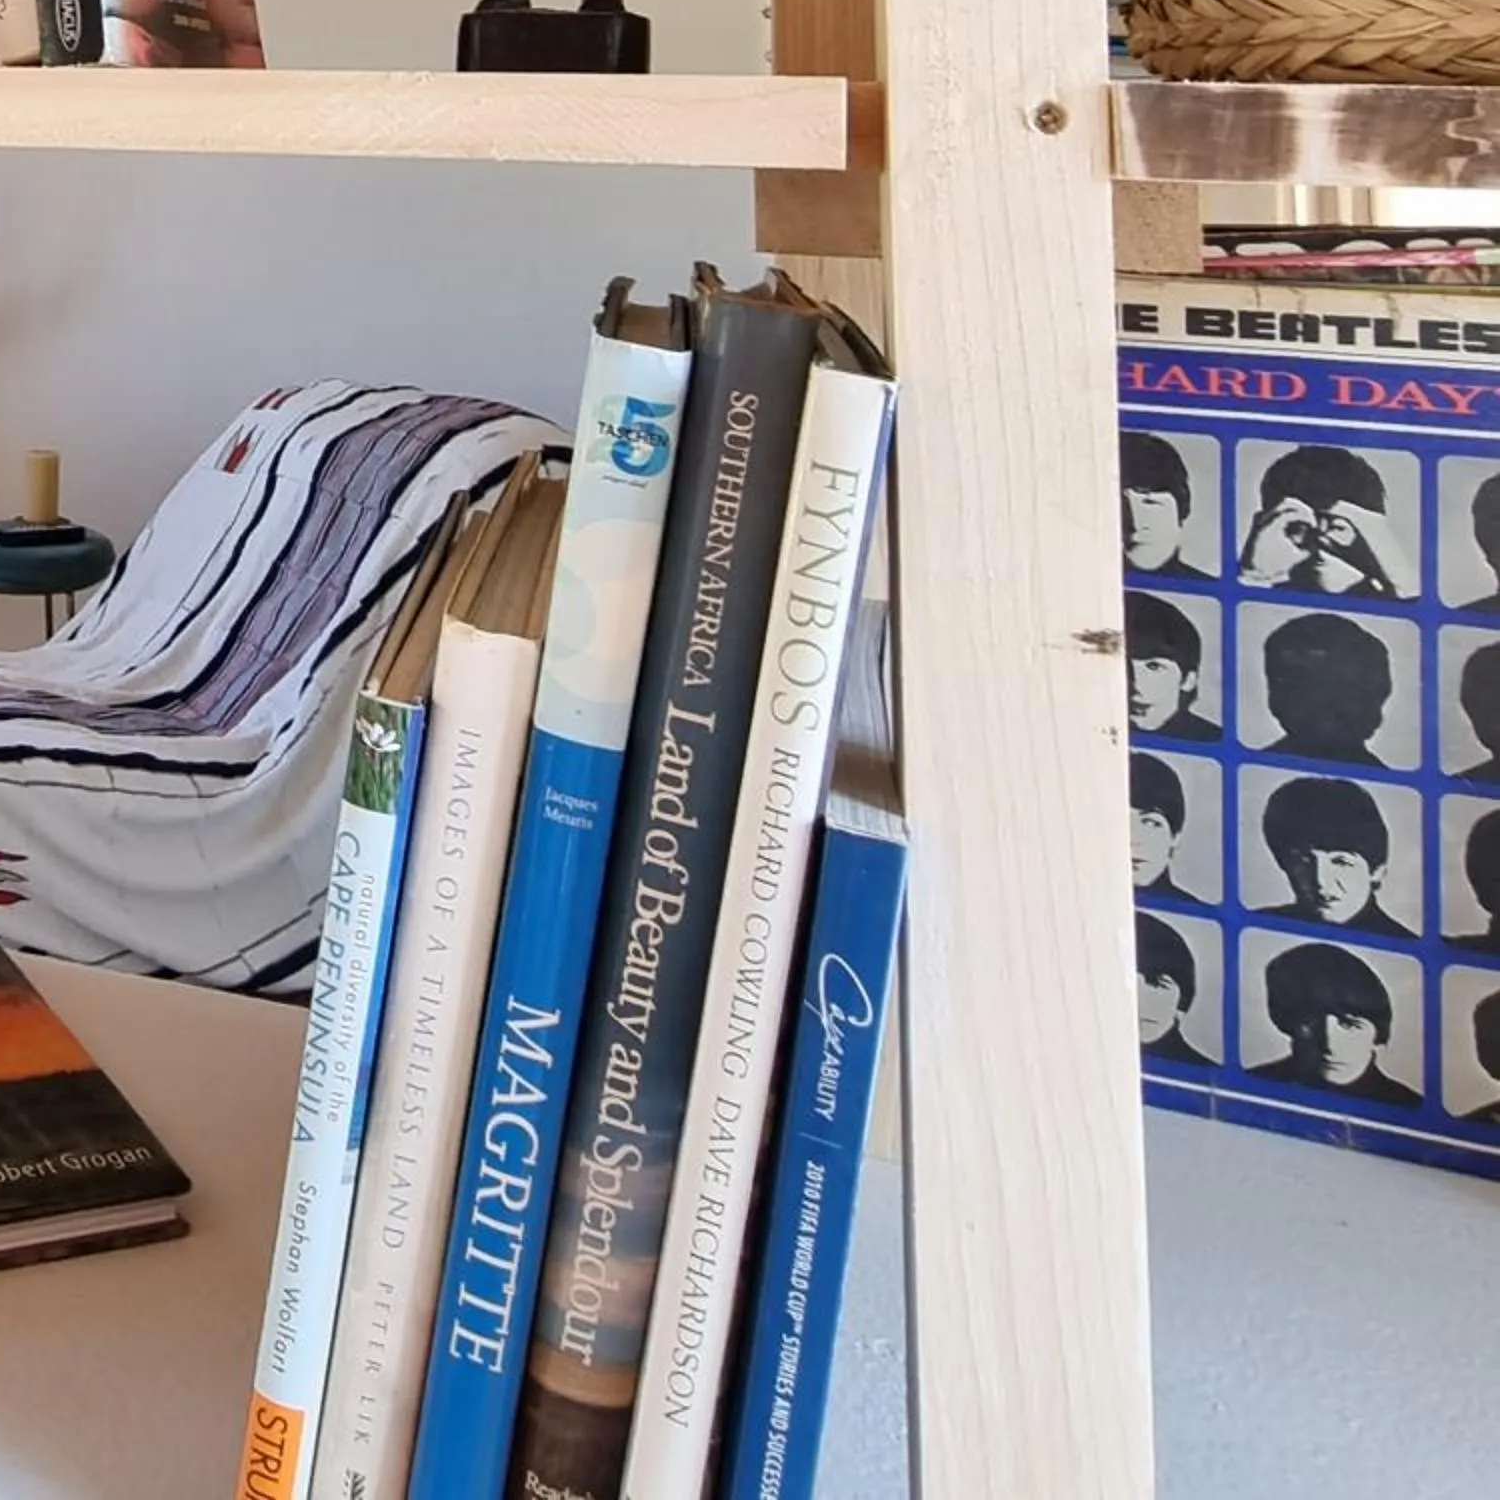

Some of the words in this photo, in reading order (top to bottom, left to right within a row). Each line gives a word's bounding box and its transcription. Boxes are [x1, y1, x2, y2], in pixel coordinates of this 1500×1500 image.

[1184, 306, 1500, 355] BEATLES
[701, 389, 759, 572] SOUTHERN
[682, 569, 733, 688] AFRICA
[770, 459, 862, 733] FYNBOS
[442, 727, 482, 860] IMAGES
[543, 786, 599, 814] Jacques
[649, 700, 718, 830] Land
[541, 803, 594, 831] Meuris
[641, 827, 690, 886] of
[751, 747, 802, 903] RICHARD
[326, 830, 361, 926] CAPE
[354, 873, 375, 951] natural
[431, 874, 459, 919] OF
[424, 935, 449, 953] A
[606, 882, 686, 1045] Beauty
[291, 932, 346, 1145] PENINSULA
[333, 959, 368, 1055] diversity
[721, 911, 773, 1080] COWLING
[335, 1054, 353, 1083] of
[399, 974, 445, 1137] TIMELESS
[598, 1042, 648, 1137] and
[59, 1145, 154, 1176] Grogan
[447, 994, 563, 1374] MAGRITTE
[702, 1095, 742, 1189] DAVE
[805, 1159, 826, 1194] 2010
[286, 1181, 318, 1275] Stephan
[378, 1152, 418, 1251] LAND
[797, 1194, 824, 1235] FIFA
[557, 1135, 645, 1367] Splendour
[790, 1233, 818, 1292] WORLD
[271, 1286, 302, 1375] Wolfart
[365, 1280, 394, 1374] PETER
[664, 1194, 726, 1429] RICHARDSON
[775, 1333, 802, 1399] STORIES
[353, 1393, 376, 1445] LIK
[770, 1398, 793, 1434] AND
